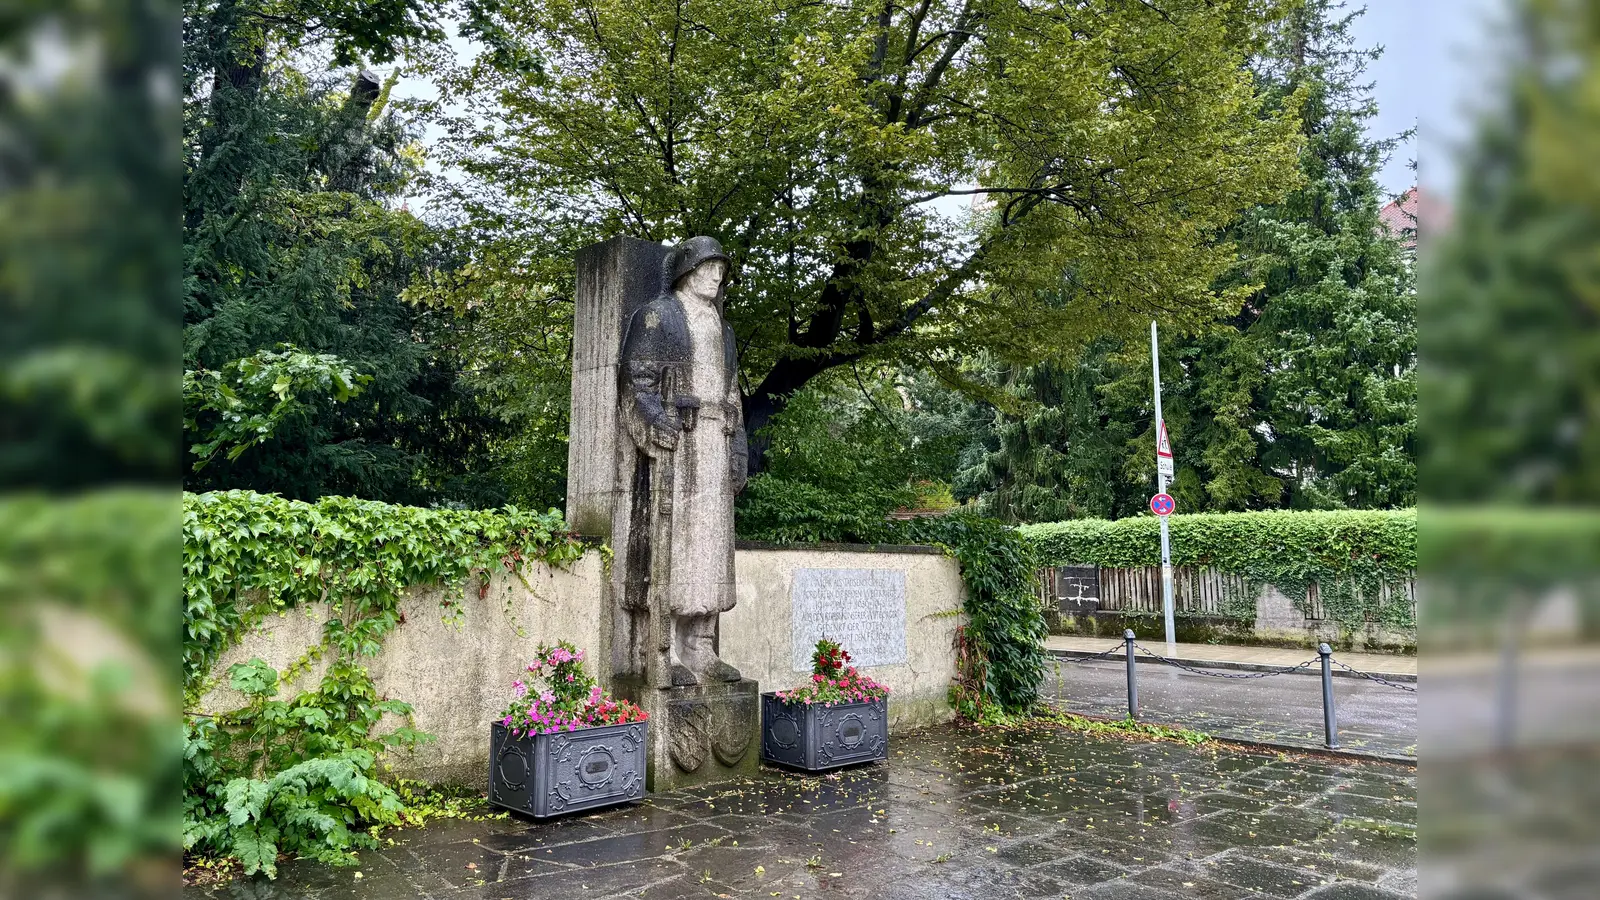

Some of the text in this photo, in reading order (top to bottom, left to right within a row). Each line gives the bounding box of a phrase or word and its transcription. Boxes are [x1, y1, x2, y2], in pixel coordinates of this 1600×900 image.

[1160, 461, 1172, 471] Schule
[817, 622, 884, 631] GEDENKT DER TOTEN
[855, 633, 866, 641] DEN
[867, 632, 890, 641] FRIEDEN
